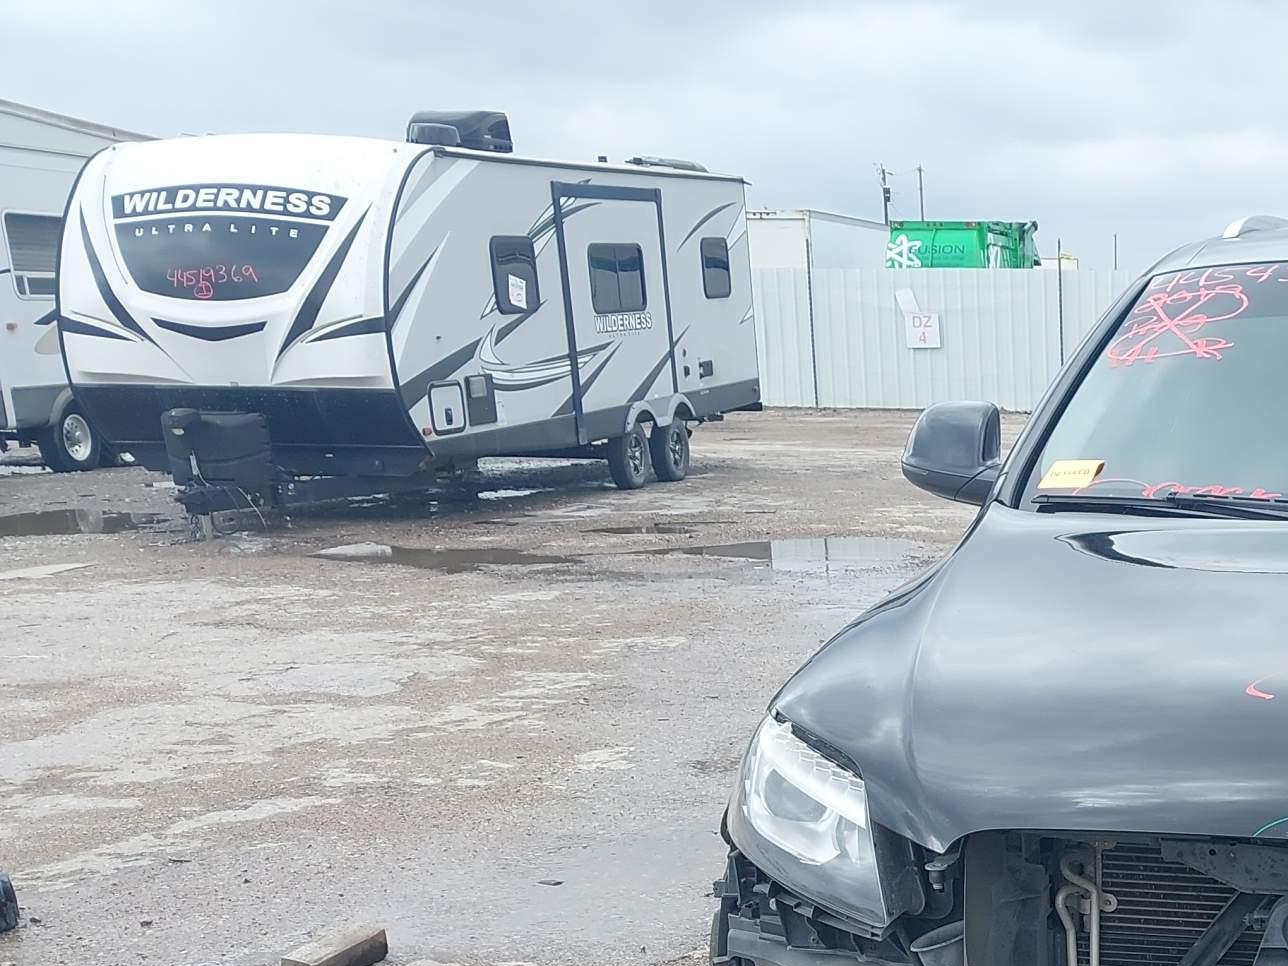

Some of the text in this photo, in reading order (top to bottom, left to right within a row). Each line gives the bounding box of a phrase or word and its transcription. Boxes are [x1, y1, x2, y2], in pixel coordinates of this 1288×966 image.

[123, 187, 332, 216] WILDERNESS
[135, 223, 299, 238] ULTRA LITE
[594, 312, 653, 333] WILDERNESS
[911, 315, 933, 329] DZ
[918, 331, 928, 345] 4
